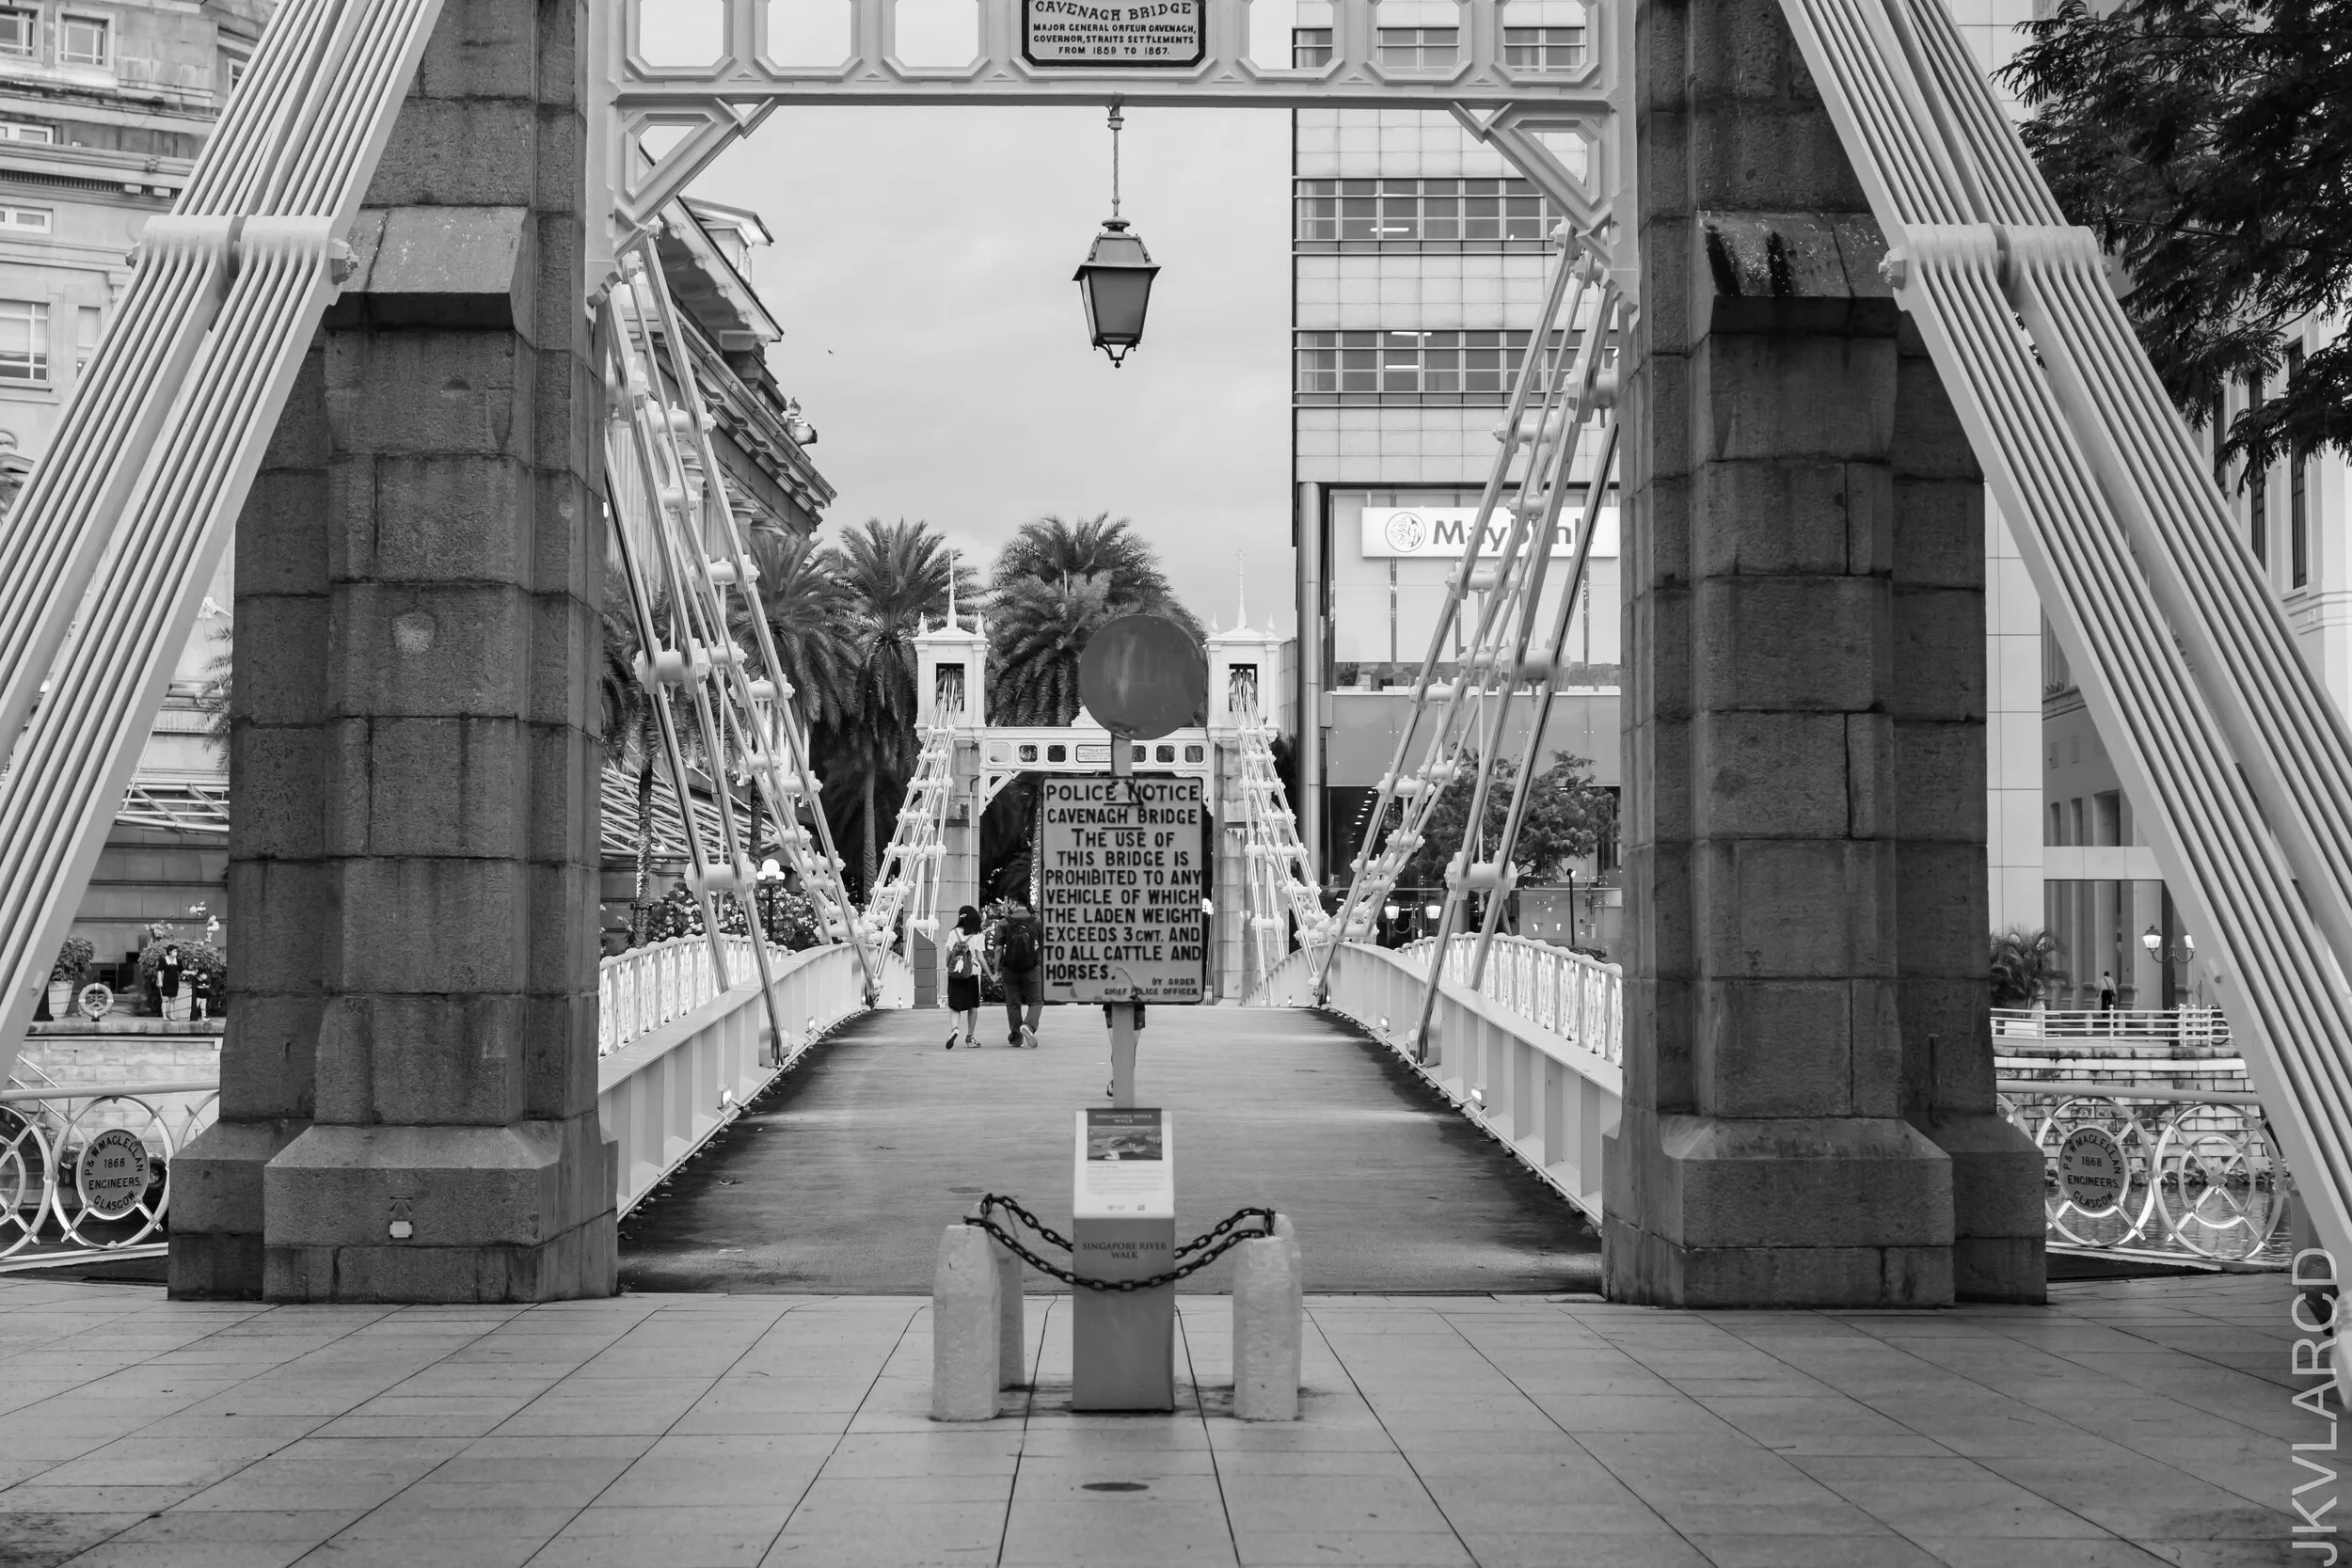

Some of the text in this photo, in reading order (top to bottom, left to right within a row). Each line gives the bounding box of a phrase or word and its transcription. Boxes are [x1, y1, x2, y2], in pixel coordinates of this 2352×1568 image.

[1035, 0, 1191, 21] CAVENAGH BRIDGE
[1149, 24, 1196, 34] CAVENAGH,
[1128, 35, 1194, 43] SETTLEMENTS
[1144, 46, 1169, 55] 1867.
[1046, 784, 1200, 800] POLICE NOTICE
[1047, 808, 1197, 824] CAVENAGH BRIDGE
[1072, 828, 1175, 847] THE USE OF
[1057, 850, 1188, 866] THIS BRIDGE IS
[1046, 869, 1201, 885] PROHIBITED TO ANY
[1046, 889, 1200, 905] VEHICLE OF WHICH
[1045, 908, 1201, 923] THE LADEN WEIGHT
[1045, 927, 1200, 942] EXCEEDS 3 CWT. AND
[1044, 945, 1201, 961] TO ALL CATTLE AND
[1045, 964, 1116, 980] HORSES.
[103, 1157, 125, 1168] 1868
[2081, 1156, 2102, 1166] 1868
[1082, 1242, 1167, 1250] SINGAPORE RIVER
